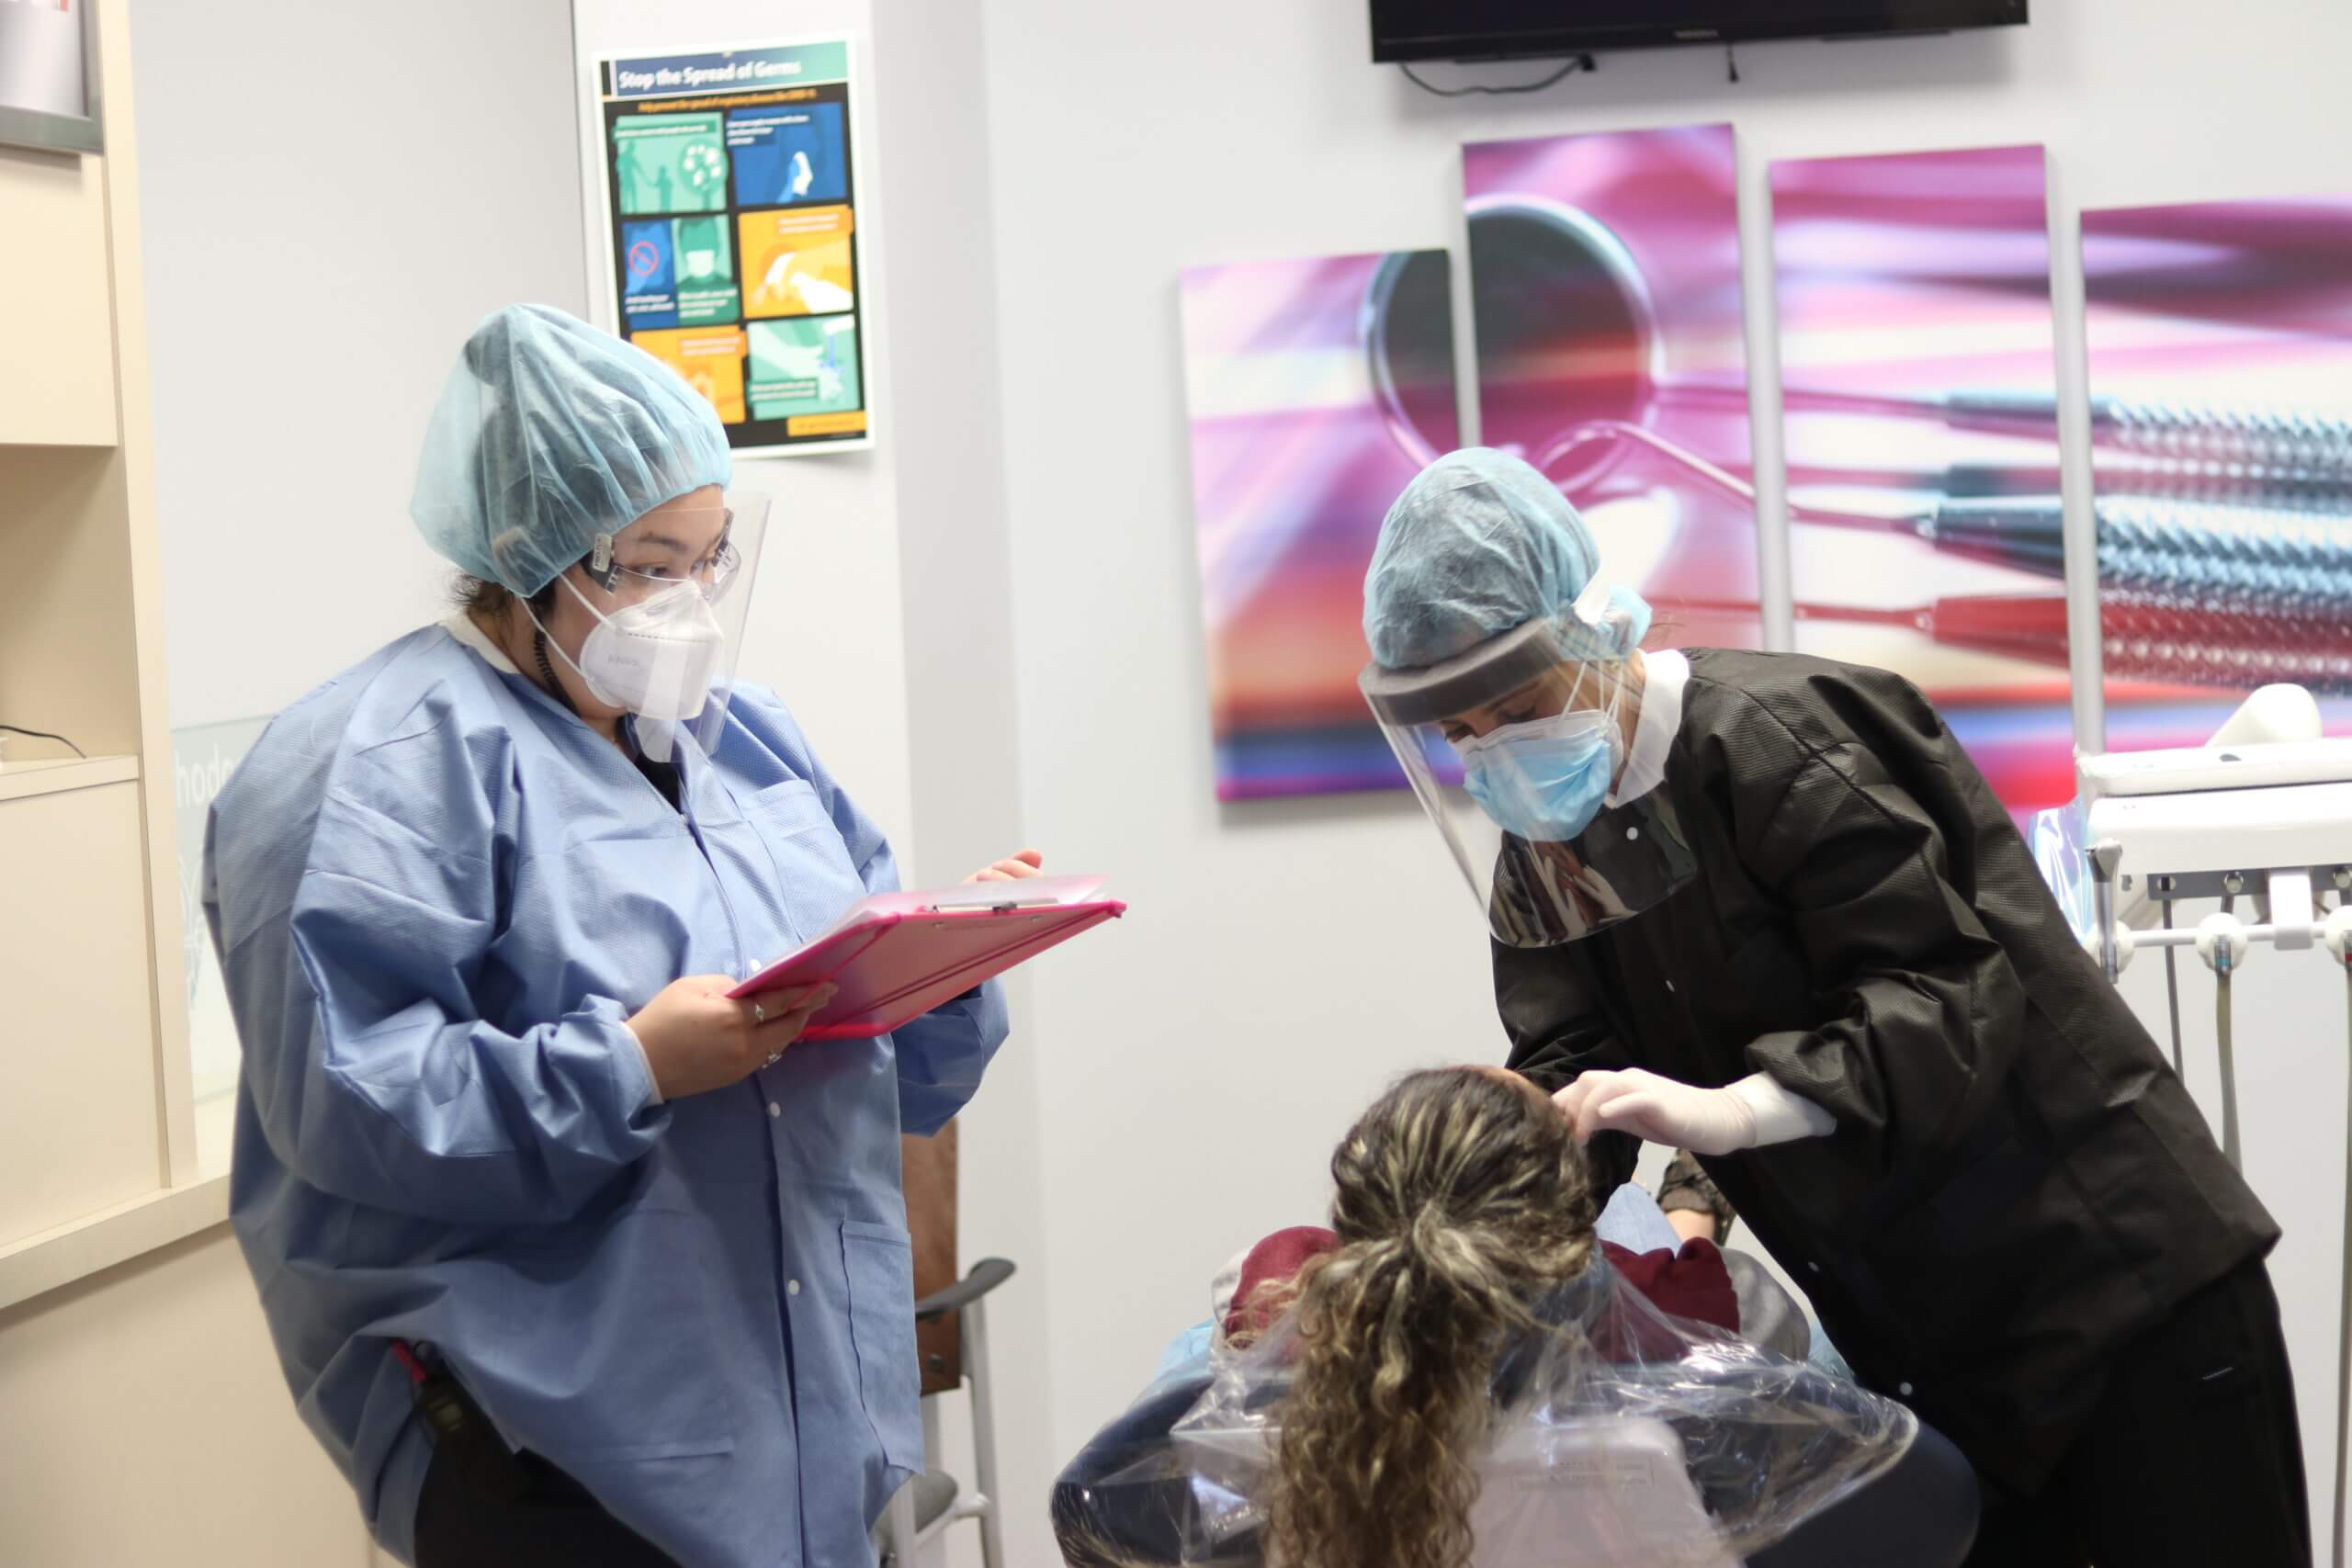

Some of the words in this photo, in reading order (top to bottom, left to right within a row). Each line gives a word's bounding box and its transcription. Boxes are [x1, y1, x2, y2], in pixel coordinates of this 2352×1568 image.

[619, 71, 655, 90] Stop
[656, 68, 682, 86] the
[683, 62, 736, 86] Spread
[737, 61, 754, 80] of
[754, 61, 801, 78] Germs
[175, 741, 241, 808] hodo
